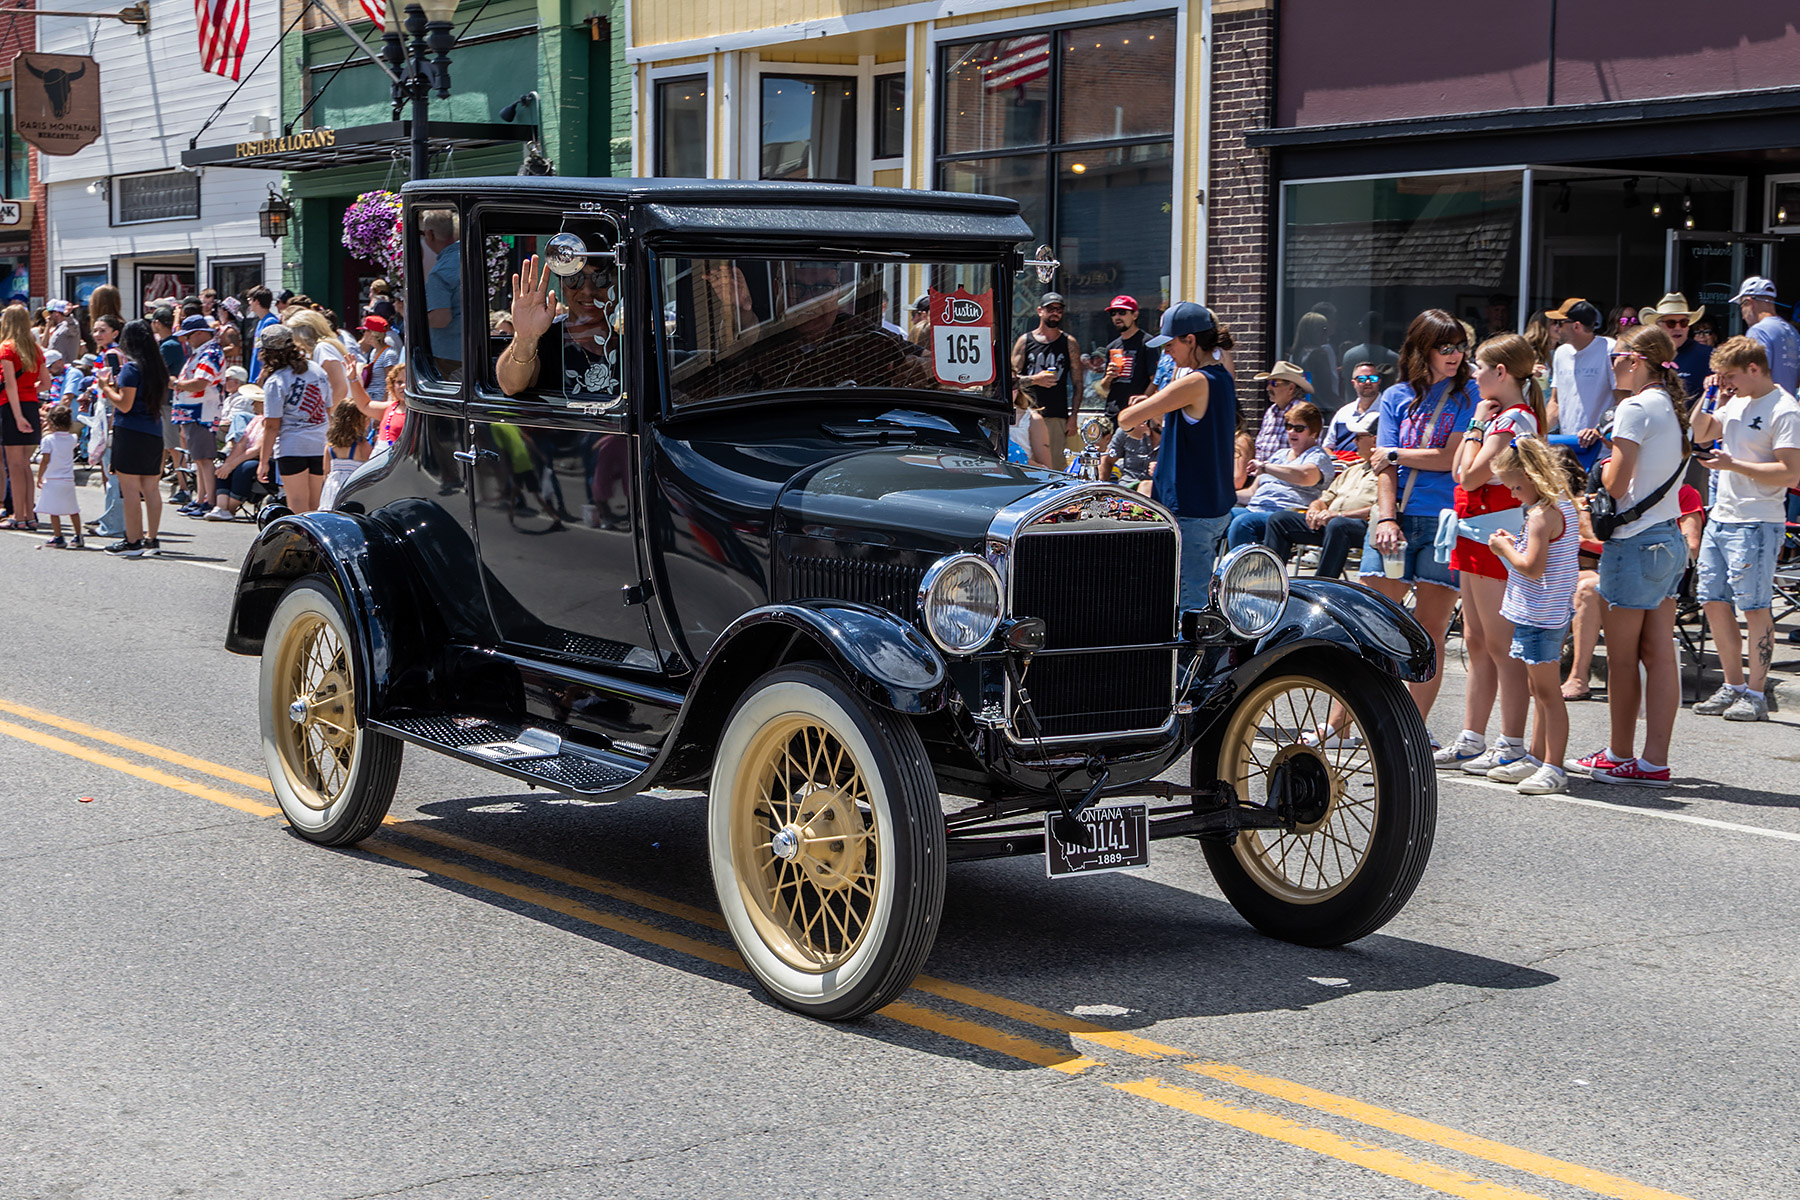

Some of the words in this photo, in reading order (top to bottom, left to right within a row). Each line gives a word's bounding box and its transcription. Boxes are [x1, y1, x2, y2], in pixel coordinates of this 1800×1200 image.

[20, 121, 47, 130] PARIS
[49, 123, 97, 132] MONTANA
[38, 132, 80, 140] MERCANTILE
[236, 138, 277, 158] FOSTER
[278, 137, 287, 152] &
[288, 130, 335, 151] LOGAN'S
[941, 297, 980, 324] Justin
[946, 334, 981, 364] 165
[1076, 808, 1123, 823] ONTANA
[1098, 853, 1122, 865] 1889
